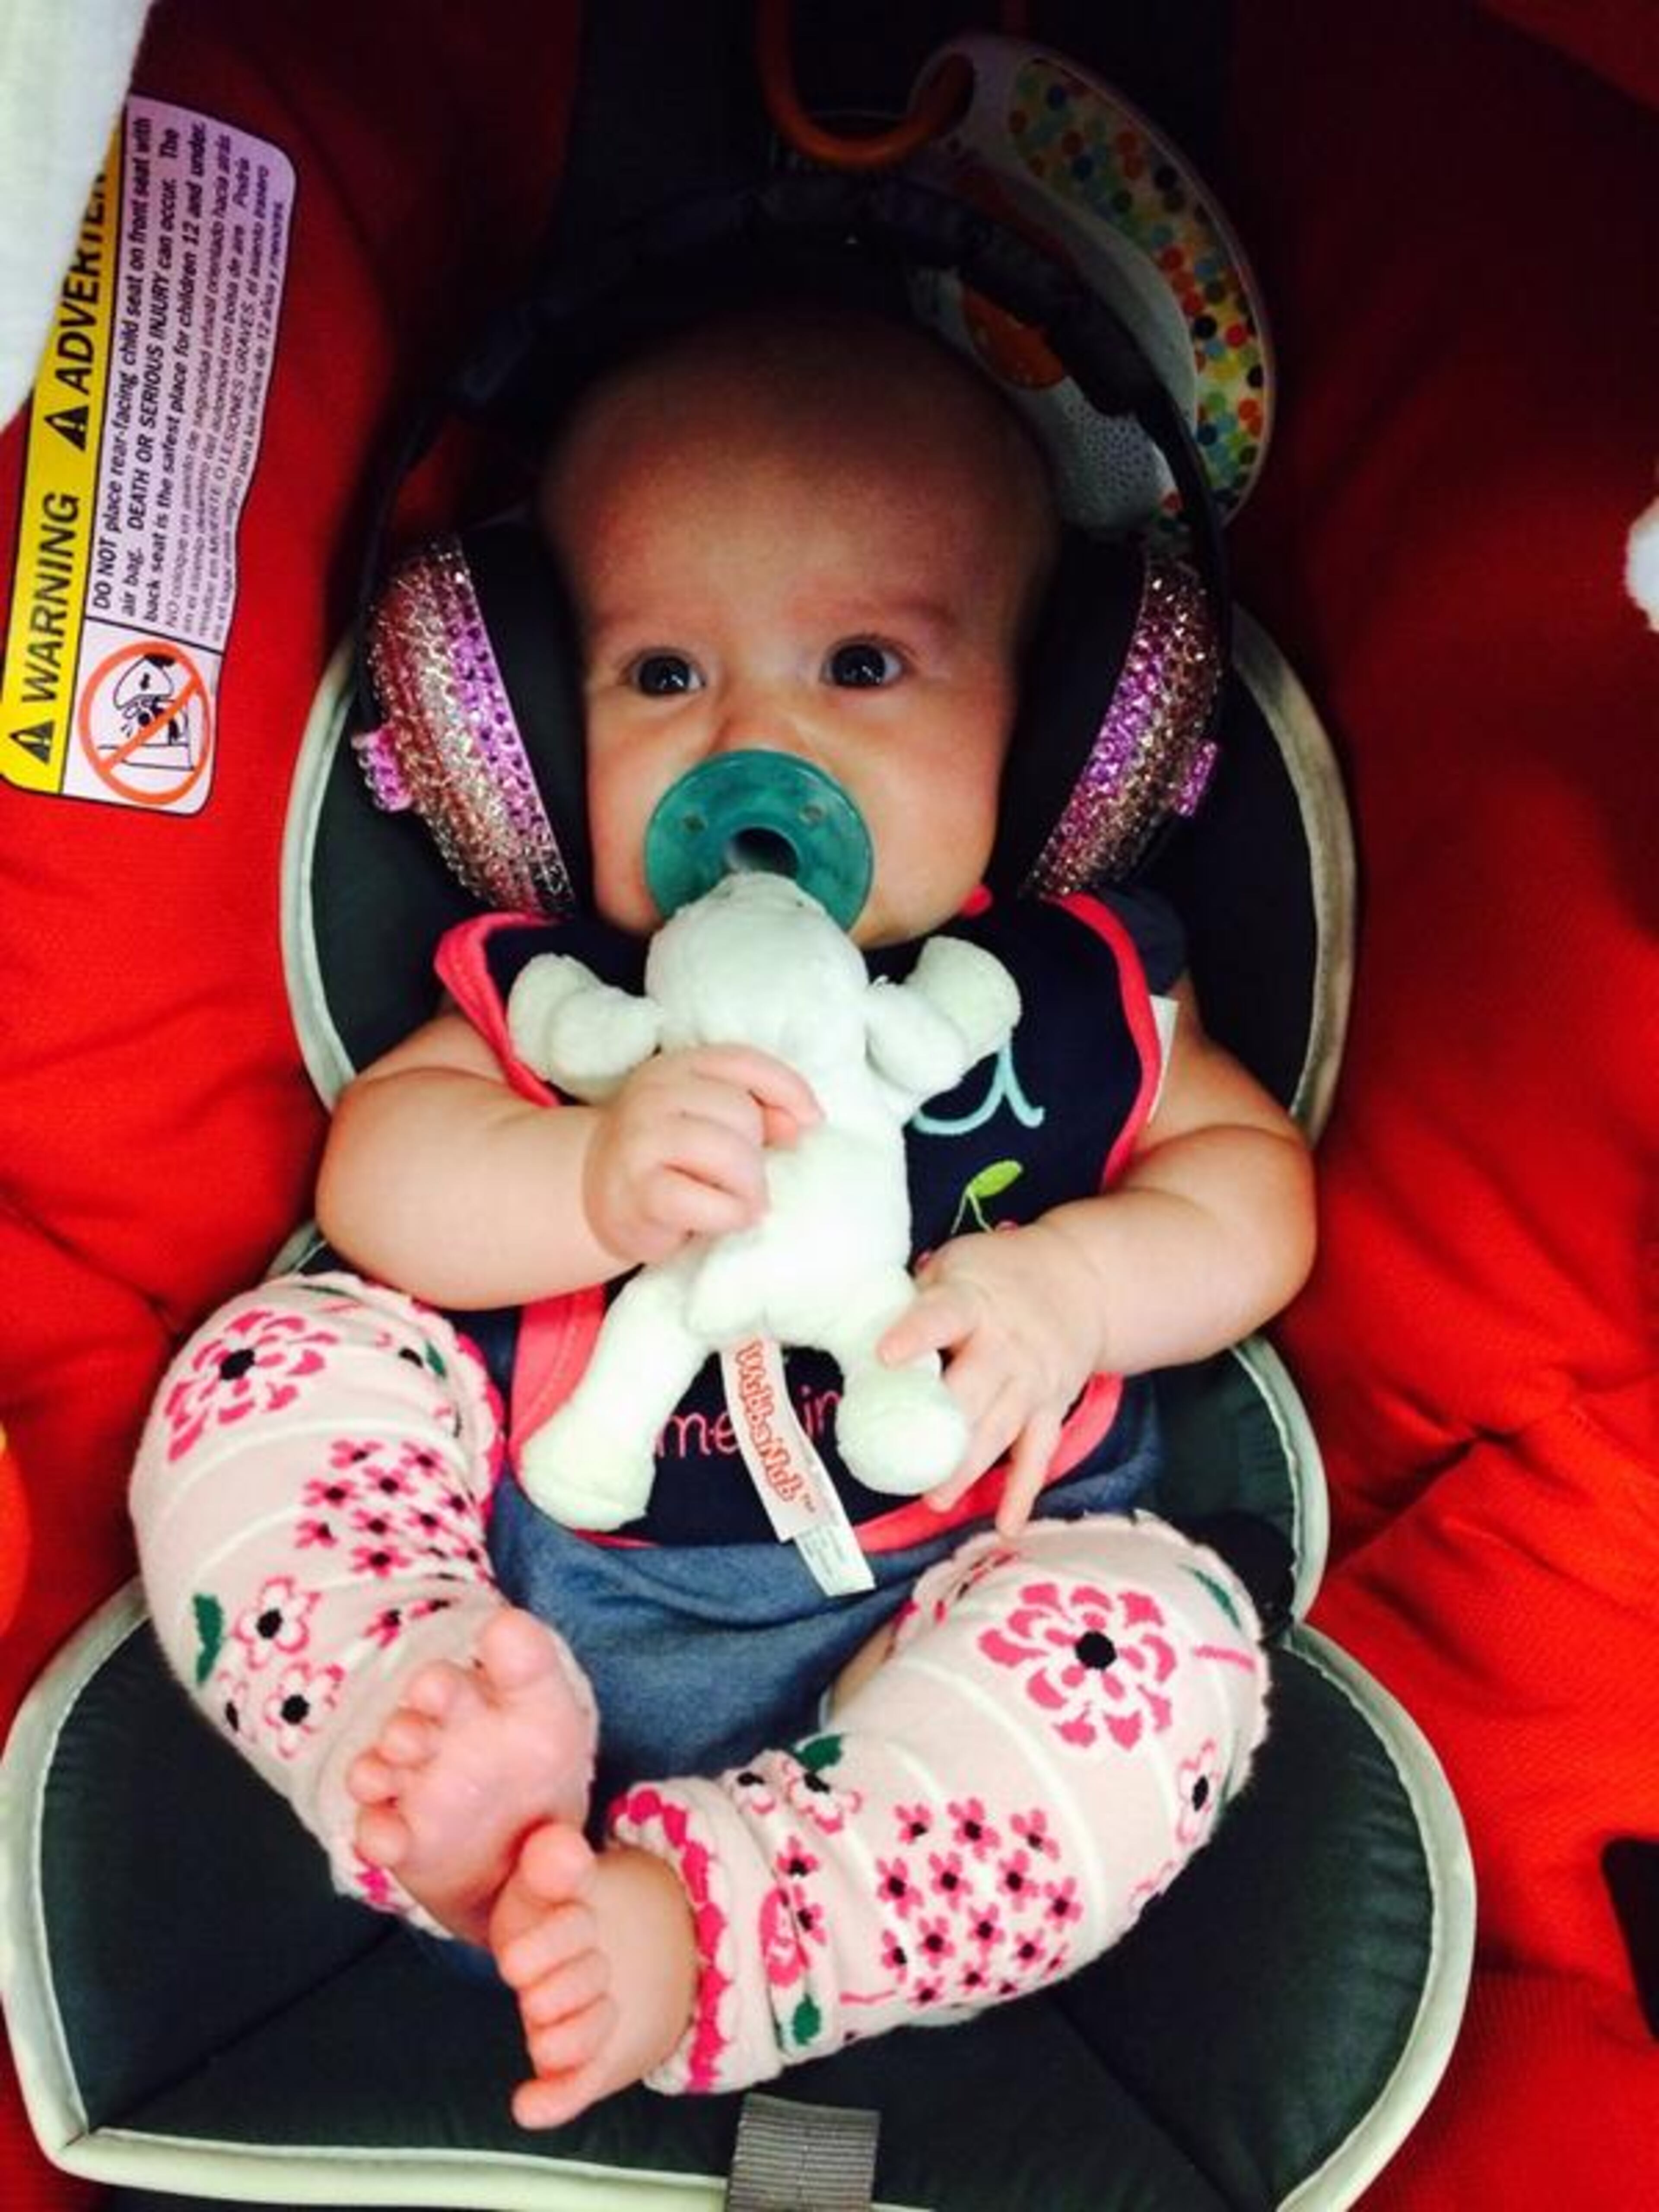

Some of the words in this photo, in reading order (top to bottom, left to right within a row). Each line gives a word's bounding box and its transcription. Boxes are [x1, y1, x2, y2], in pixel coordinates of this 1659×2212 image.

[133, 117, 150, 153] with
[159, 128, 179, 158] The
[188, 124, 206, 177] under.
[132, 157, 149, 197] seat
[160, 179, 176, 231] occur.
[185, 181, 202, 218] and
[128, 199, 148, 243] front
[181, 221, 200, 245] 12
[130, 248, 144, 270] on
[158, 235, 172, 269] can
[227, 257, 241, 277] de
[250, 222, 264, 277] asiento
[125, 275, 143, 316] seat
[149, 272, 168, 338] INJURY
[177, 251, 196, 327] children
[222, 281, 238, 324] bolsa
[245, 278, 257, 296] el
[119, 320, 139, 365] child
[172, 329, 189, 357] for
[222, 326, 232, 355] con
[257, 321, 270, 339] 12
[254, 346, 266, 367] de
[140, 345, 164, 427] SERIOUS
[169, 362, 187, 413] place
[111, 371, 138, 475] rear-facing
[165, 600, 178, 628] NO
[173, 537, 188, 597] coloque
[181, 513, 189, 534] un
[186, 431, 199, 451] de
[194, 350, 212, 425] seguridad
[207, 221, 224, 293] orientado
[219, 379, 245, 464] LESIONES
[135, 433, 153, 463] OR
[162, 415, 180, 472] safest
[203, 434, 216, 459] del
[237, 440, 253, 475] para
[214, 466, 226, 480] O
[103, 480, 122, 533] place
[127, 469, 149, 530] DEATH
[156, 478, 172, 508] the
[156, 514, 168, 529] is
[209, 487, 221, 554] MUERTE
[97, 537, 116, 575] NOT
[123, 549, 144, 586] bag.
[151, 532, 165, 572] seat
[191, 536, 205, 591] asiento
[209, 559, 218, 578] en
[22, 492, 80, 702] WARNING
[92, 581, 112, 609] DO
[122, 591, 136, 617] air
[144, 580, 160, 622] back
[188, 596, 196, 610] el
